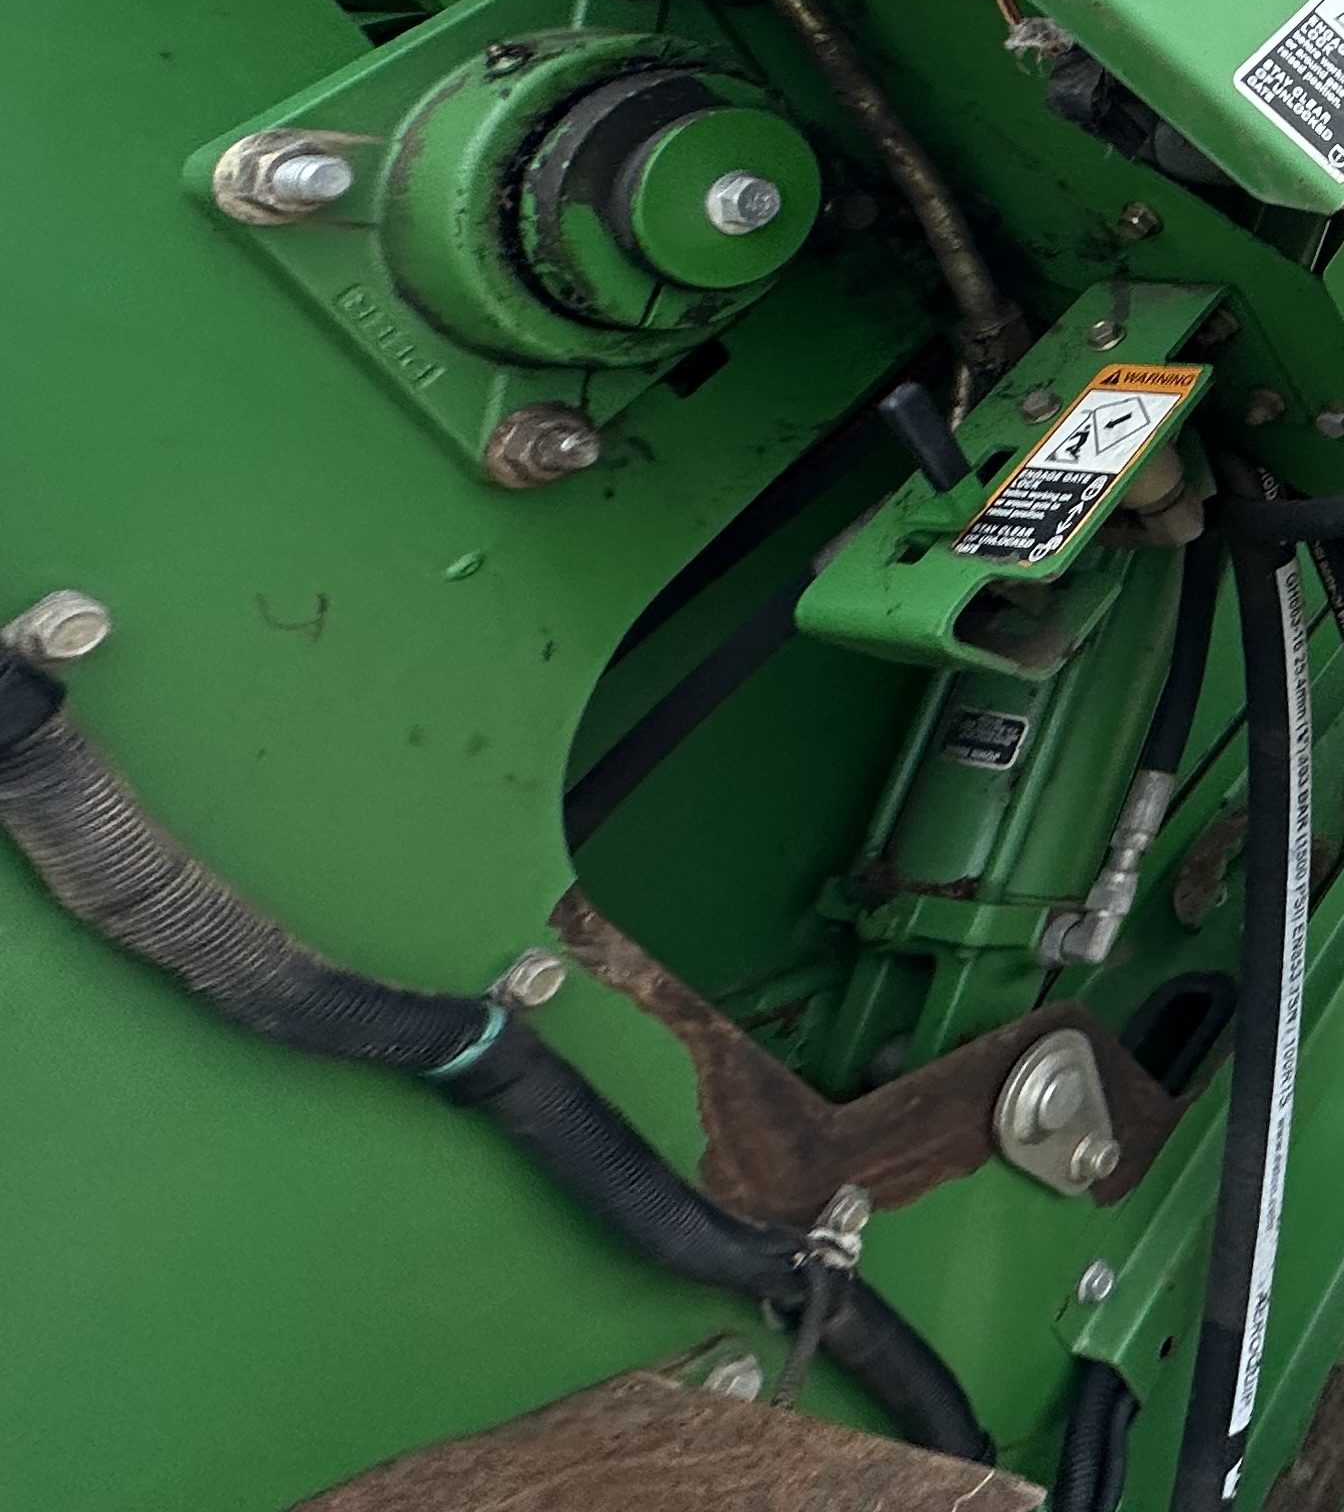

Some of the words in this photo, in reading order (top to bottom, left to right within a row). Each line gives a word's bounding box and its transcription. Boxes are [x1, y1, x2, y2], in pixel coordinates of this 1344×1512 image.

[1299, 21, 1334, 56] LOCK
[1245, 73, 1276, 103] GATE
[1260, 56, 1294, 90] STAY
[1290, 84, 1332, 125] CLEAR
[1270, 80, 1334, 143] UNLOCKED
[1118, 371, 1198, 386] WARNING
[1295, 788, 1309, 832] BAR
